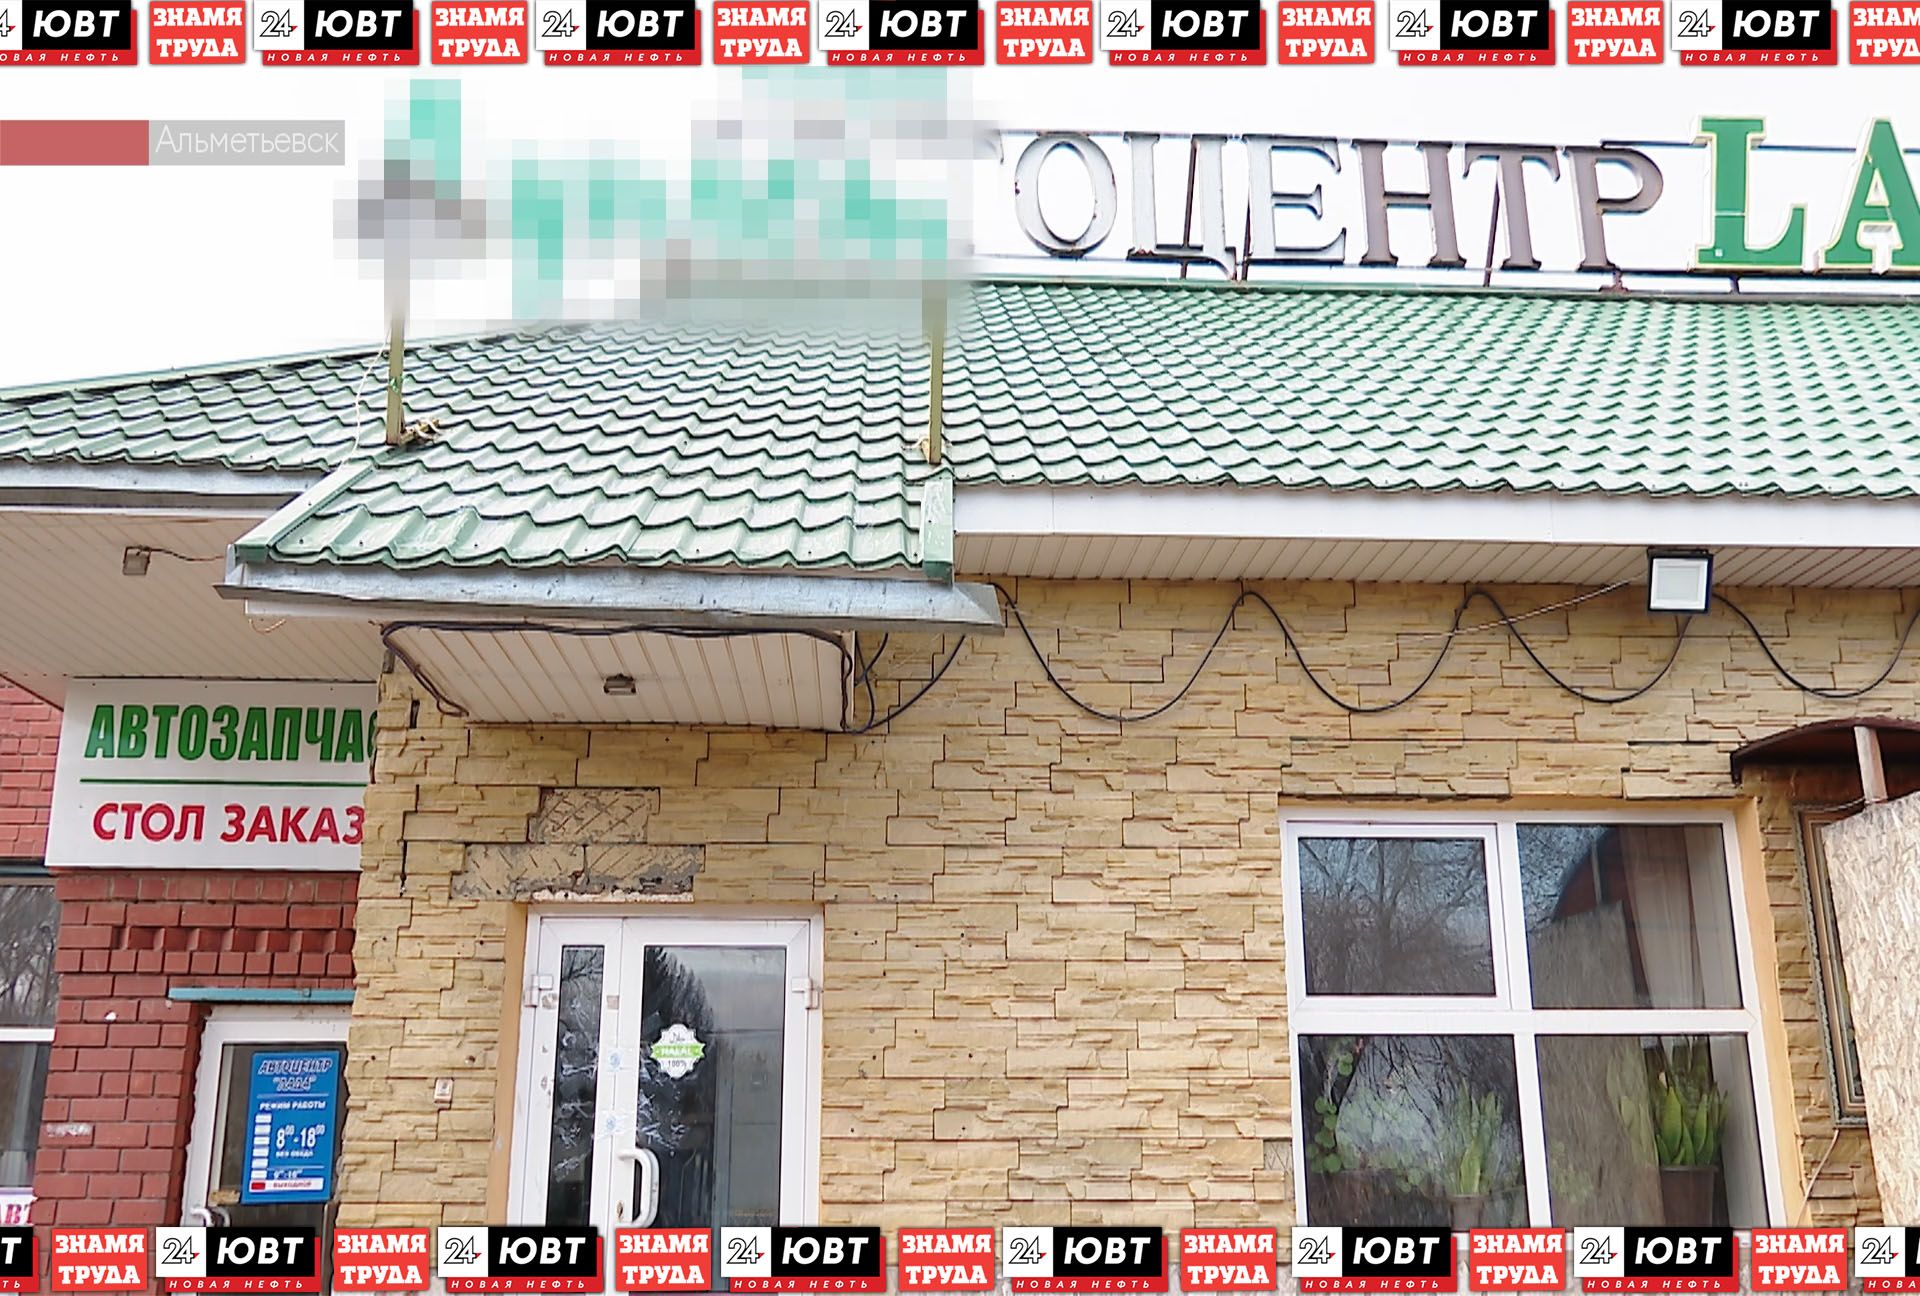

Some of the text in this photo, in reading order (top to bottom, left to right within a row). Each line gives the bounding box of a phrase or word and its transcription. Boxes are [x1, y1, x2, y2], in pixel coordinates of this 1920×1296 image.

[999, 130, 1664, 281] ОЦЕНТР
[93, 802, 365, 845] СТОЛ ЗАКАЗ
